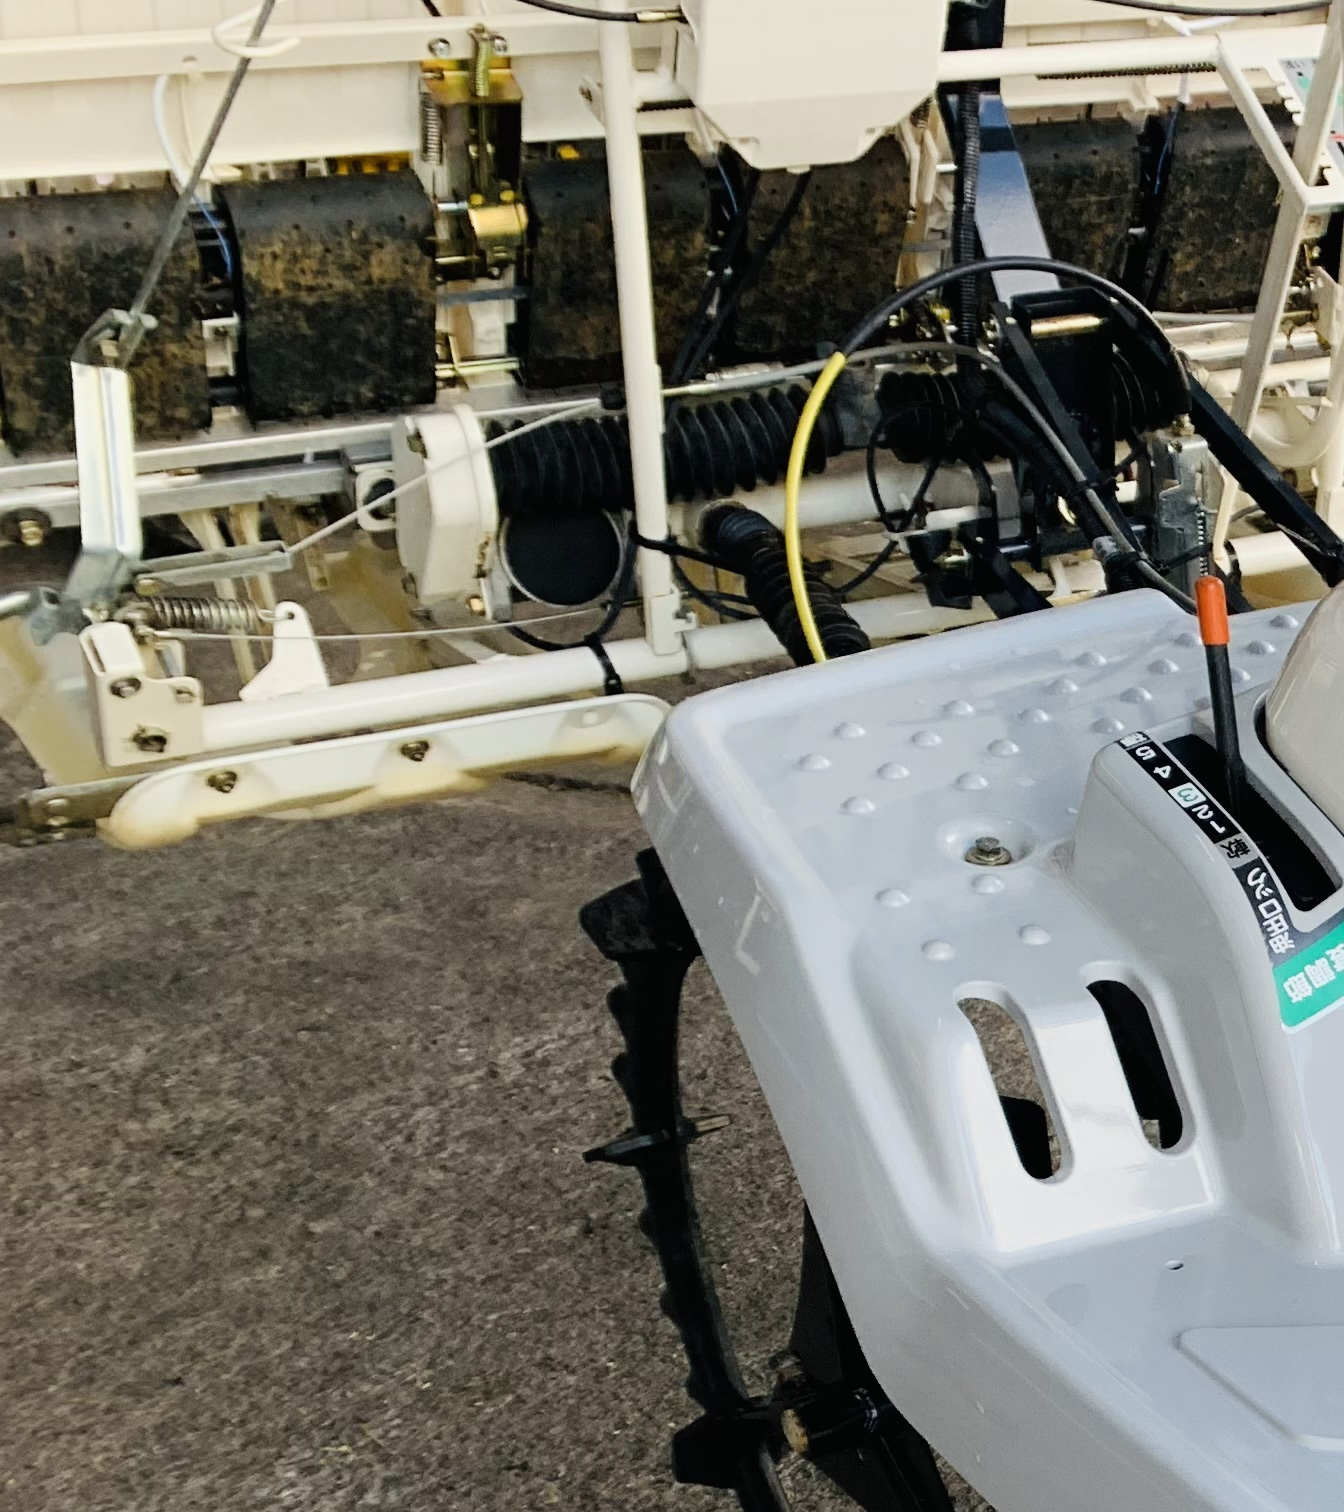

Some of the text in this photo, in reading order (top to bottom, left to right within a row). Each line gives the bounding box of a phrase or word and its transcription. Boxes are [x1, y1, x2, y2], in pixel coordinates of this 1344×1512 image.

[1135, 745, 1156, 761] 5
[1153, 765, 1172, 779] 4
[1177, 787, 1199, 803] 3
[1192, 804, 1214, 820] 2
[1210, 821, 1226, 834] 1
